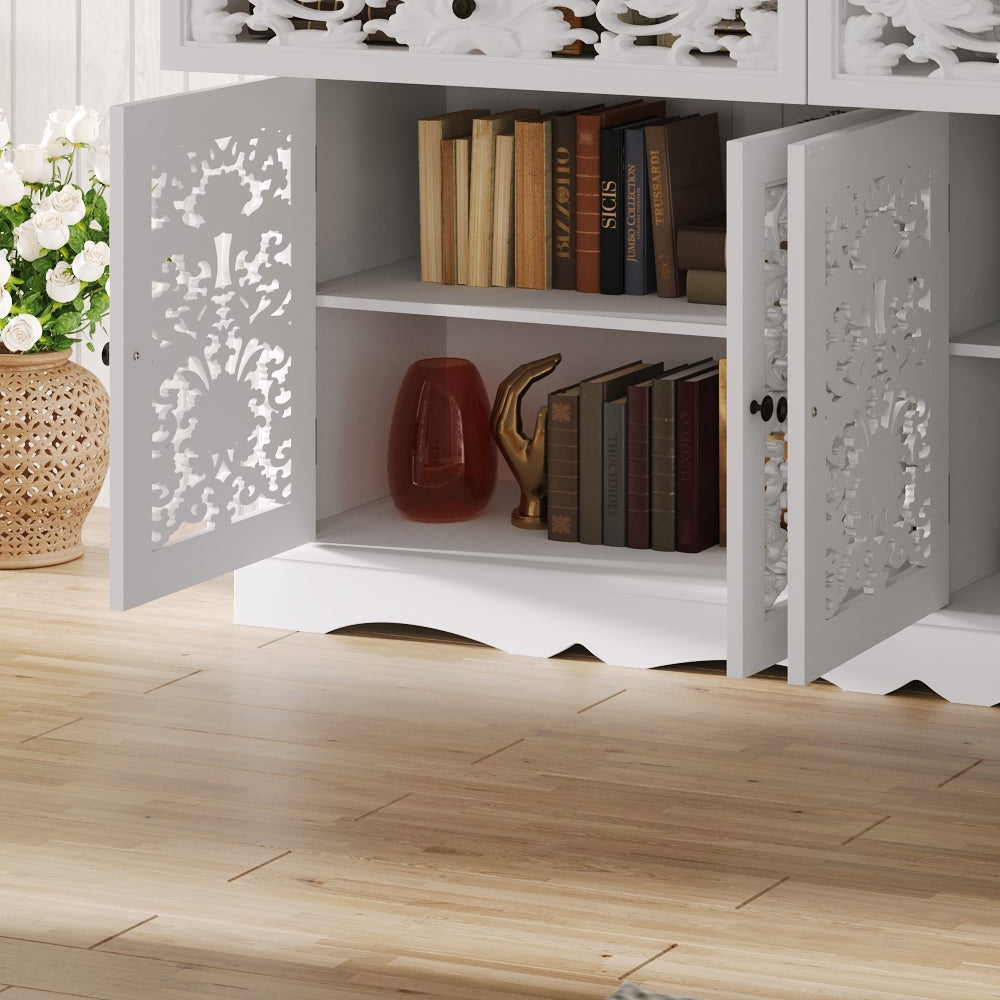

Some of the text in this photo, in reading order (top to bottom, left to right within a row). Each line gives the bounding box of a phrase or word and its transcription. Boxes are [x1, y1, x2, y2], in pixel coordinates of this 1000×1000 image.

[601, 180, 617, 229] SICIS
[626, 164, 638, 263] JUMBO COLLECTION
[649, 150, 665, 226] TRUSSARDI
[607, 435, 617, 516] THUCYDIDES
